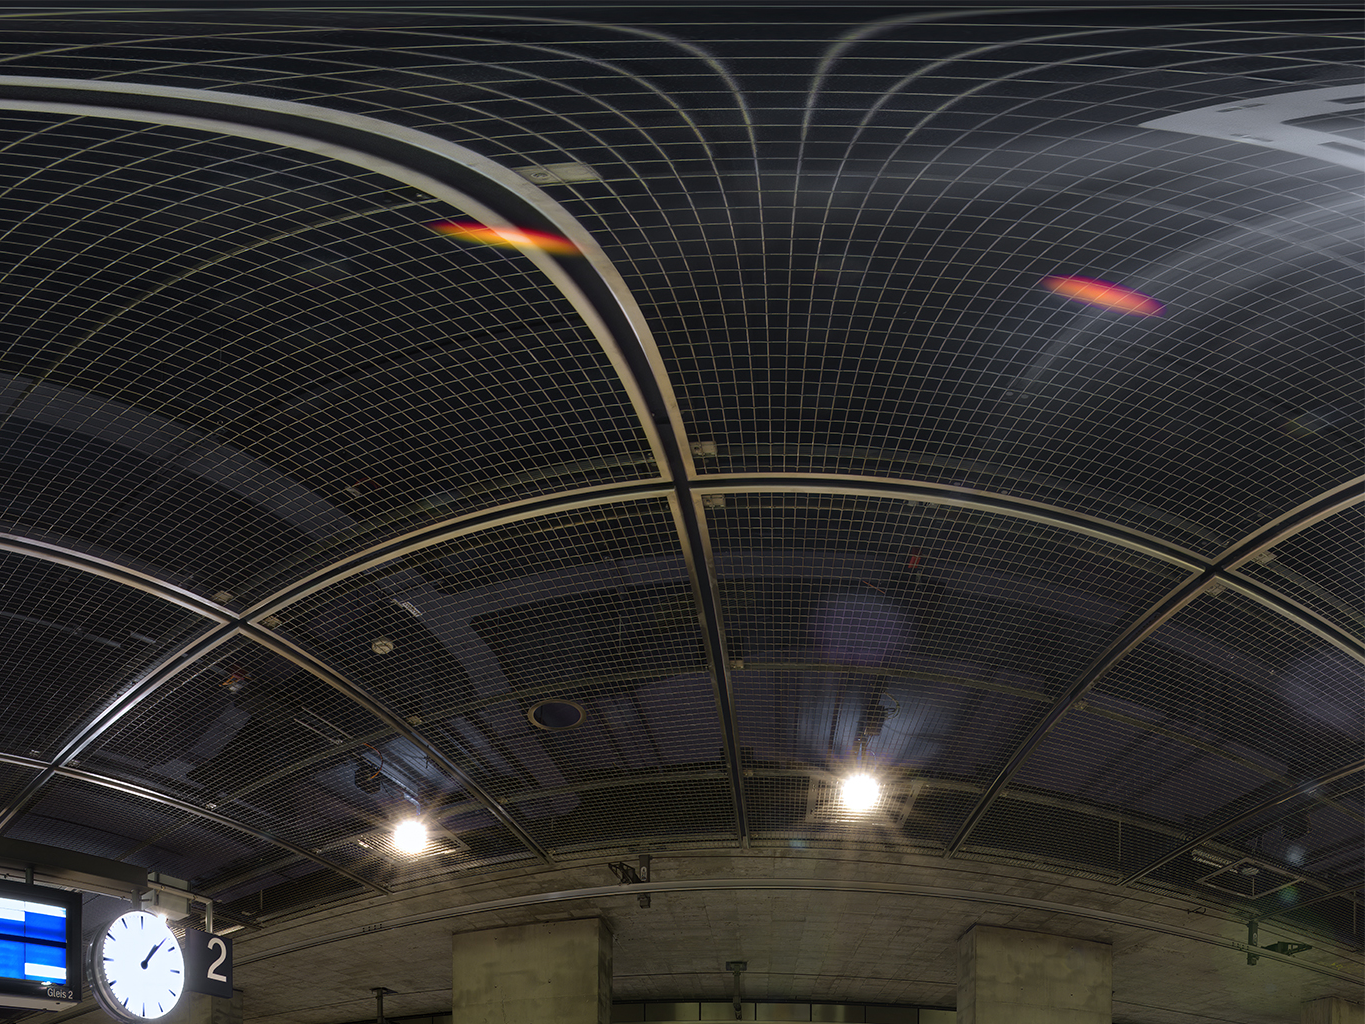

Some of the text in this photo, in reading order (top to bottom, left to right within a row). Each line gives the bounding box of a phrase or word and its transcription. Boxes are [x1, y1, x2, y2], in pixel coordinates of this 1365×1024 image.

[207, 937, 227, 983] 2
[47, 987, 74, 999] Gleis 2
